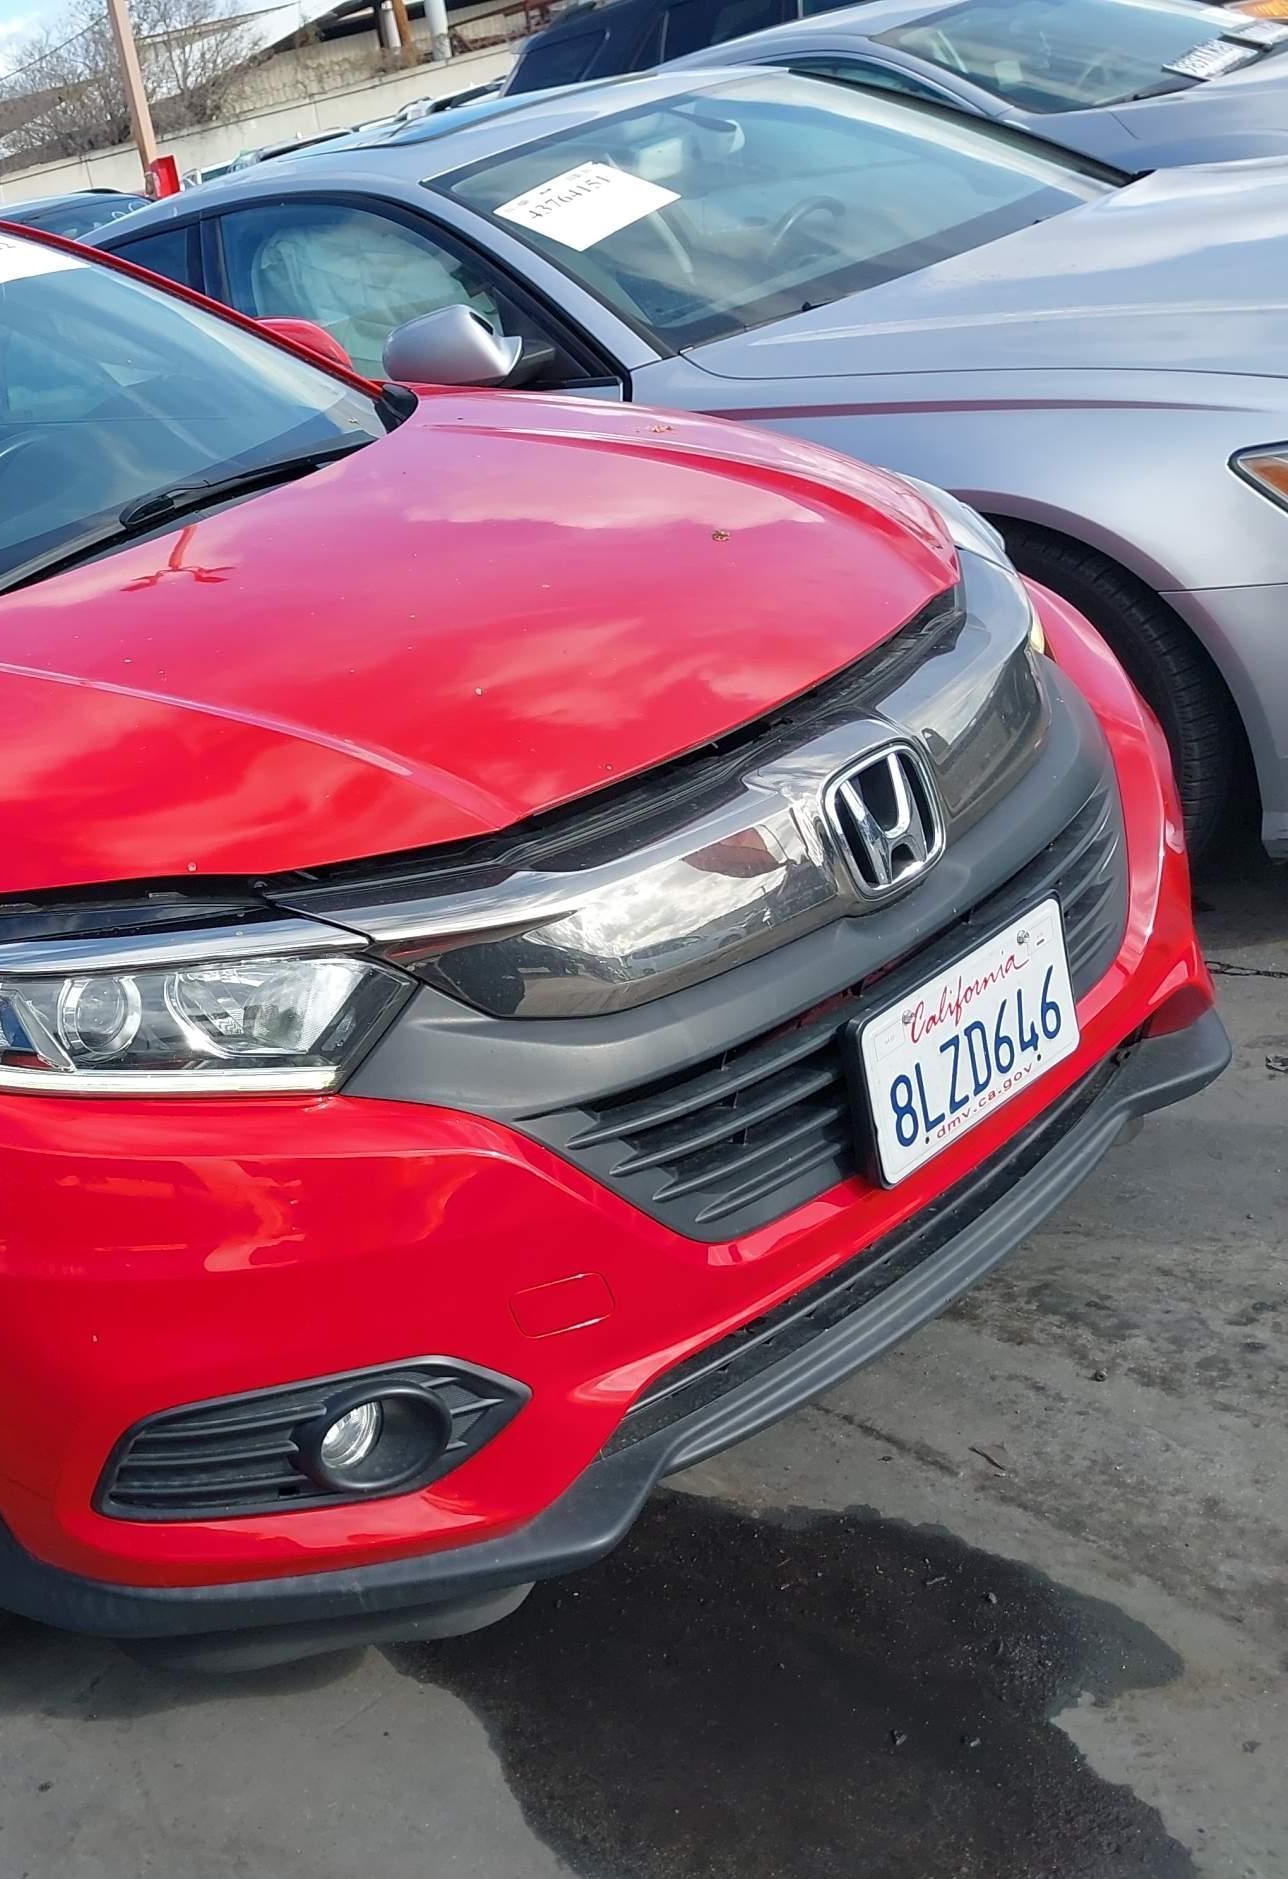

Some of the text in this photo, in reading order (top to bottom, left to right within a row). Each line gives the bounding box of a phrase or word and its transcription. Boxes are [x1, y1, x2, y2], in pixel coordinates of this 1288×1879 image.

[528, 174, 611, 219] 43764151
[910, 950, 1030, 1044] California
[890, 964, 1062, 1148] 8LZD646
[935, 1062, 1033, 1140] dmv.ca.gov
